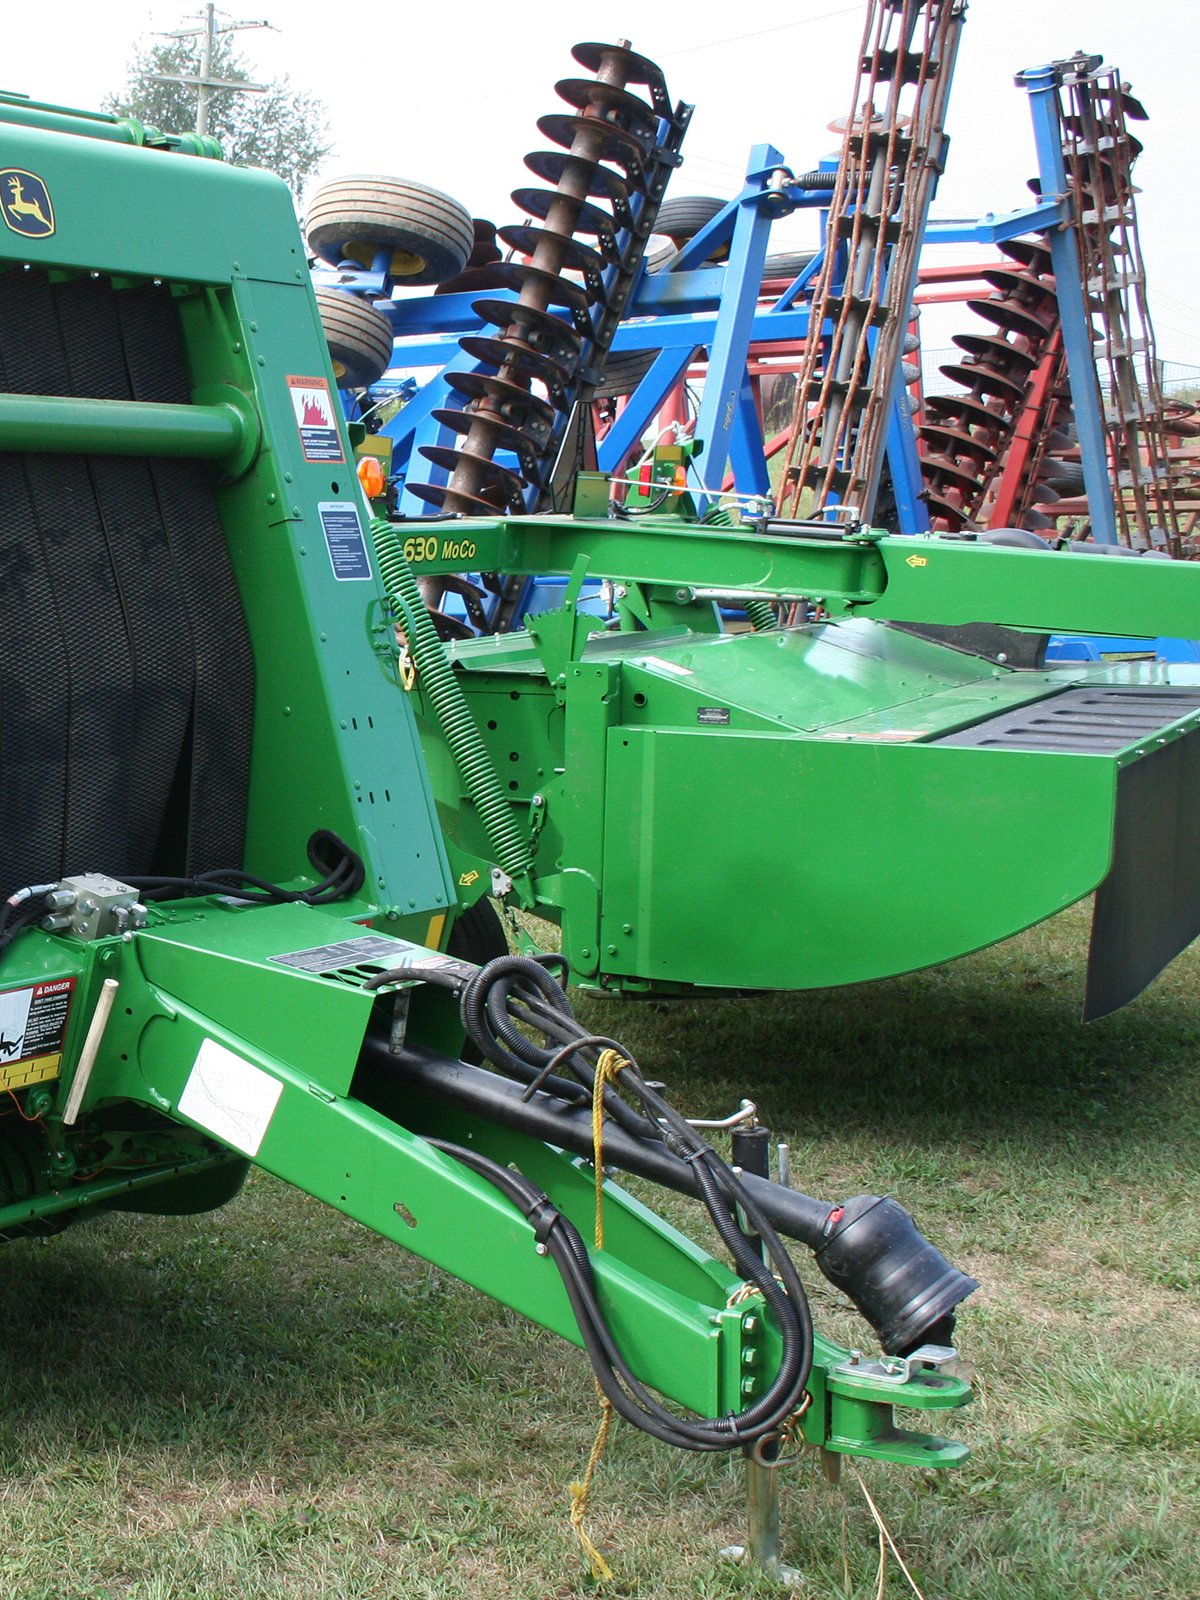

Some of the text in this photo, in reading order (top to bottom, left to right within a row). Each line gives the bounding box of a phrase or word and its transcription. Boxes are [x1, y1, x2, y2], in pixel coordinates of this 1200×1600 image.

[403, 536, 476, 562] 630 MoCo
[43, 981, 71, 993] DANGER
